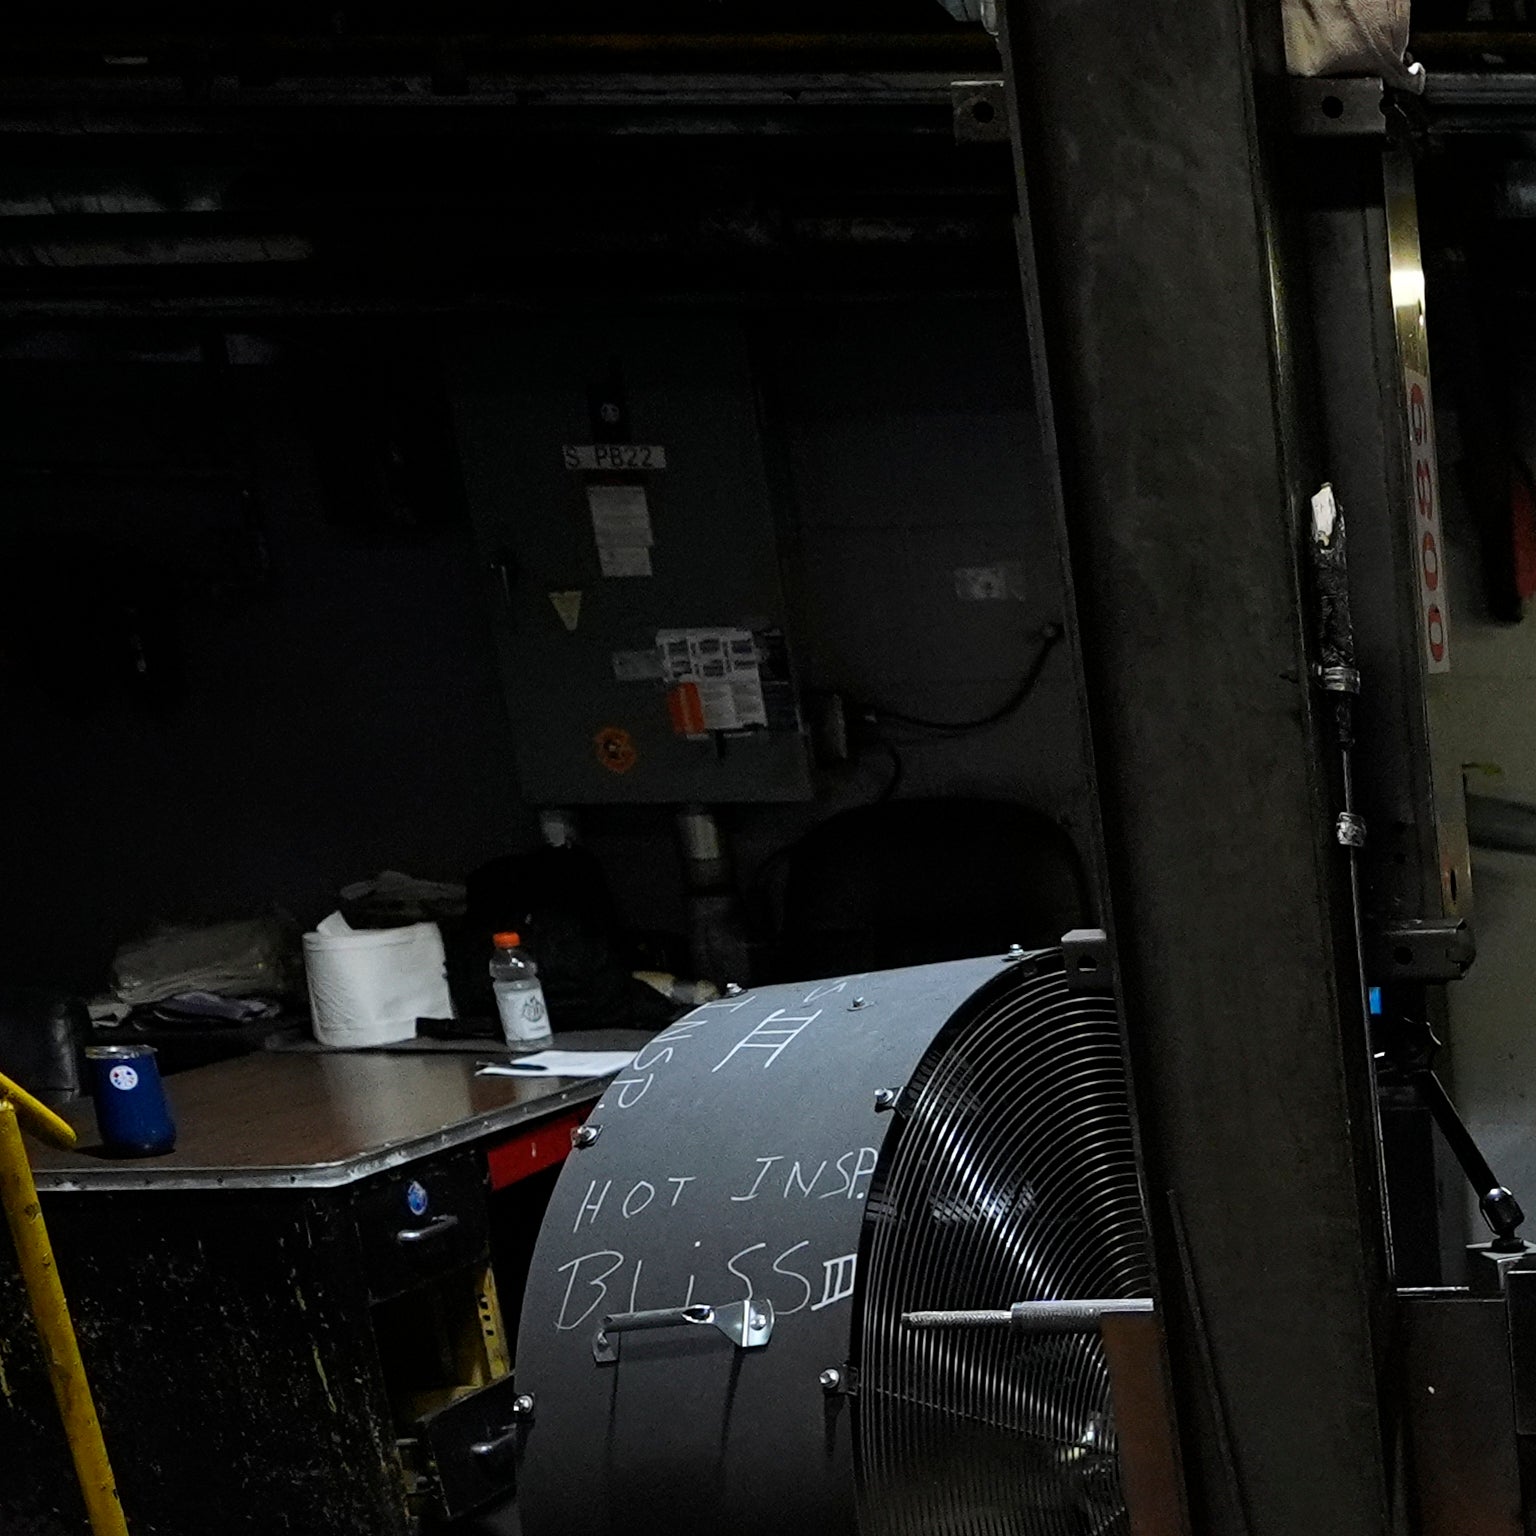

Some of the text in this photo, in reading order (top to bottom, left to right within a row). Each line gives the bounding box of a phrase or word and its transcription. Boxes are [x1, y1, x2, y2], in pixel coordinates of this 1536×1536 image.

[595, 446, 652, 468] PB22
[573, 1147, 878, 1234] HOT INSP.
